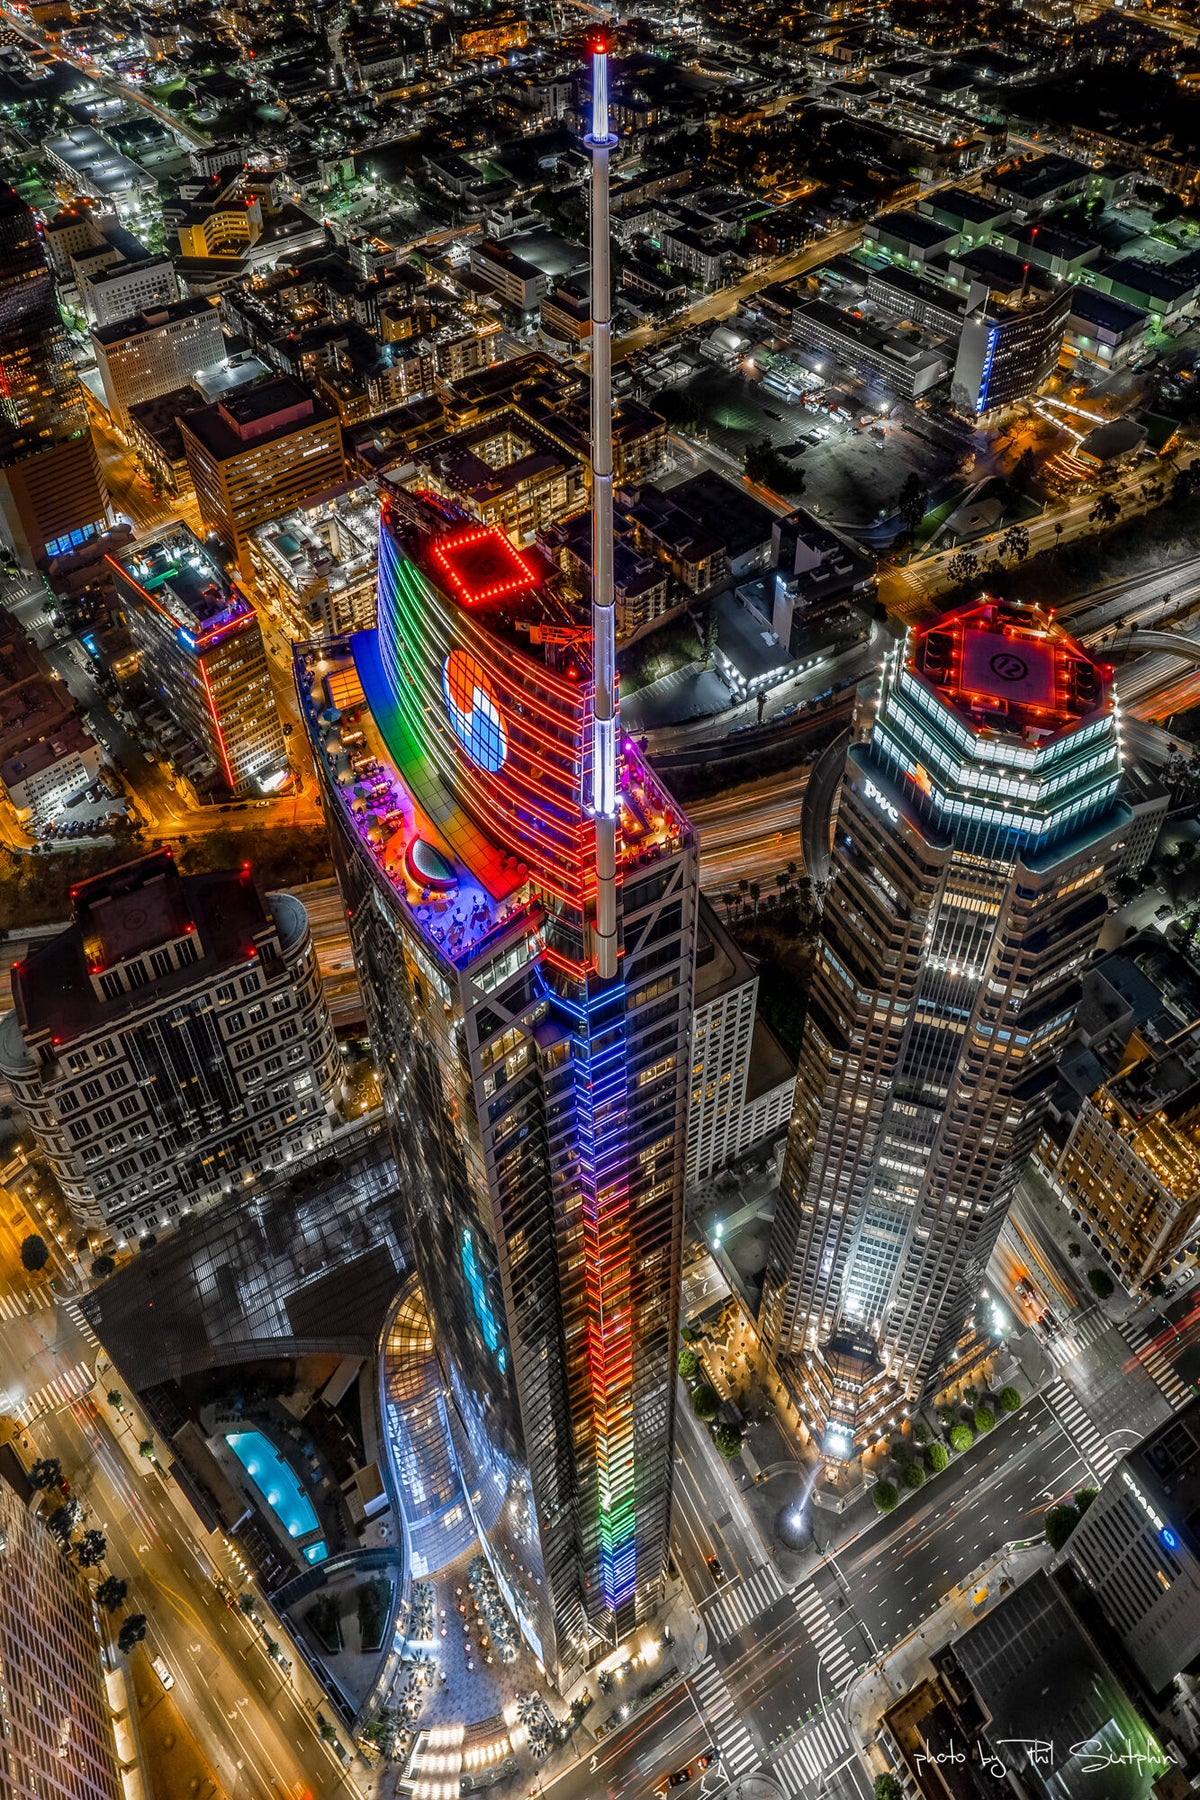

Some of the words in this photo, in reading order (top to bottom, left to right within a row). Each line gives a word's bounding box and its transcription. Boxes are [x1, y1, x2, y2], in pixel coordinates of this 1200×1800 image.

[997, 657, 1021, 677] 12
[863, 778, 899, 823] pwc
[1122, 1472, 1164, 1531] CHASE
